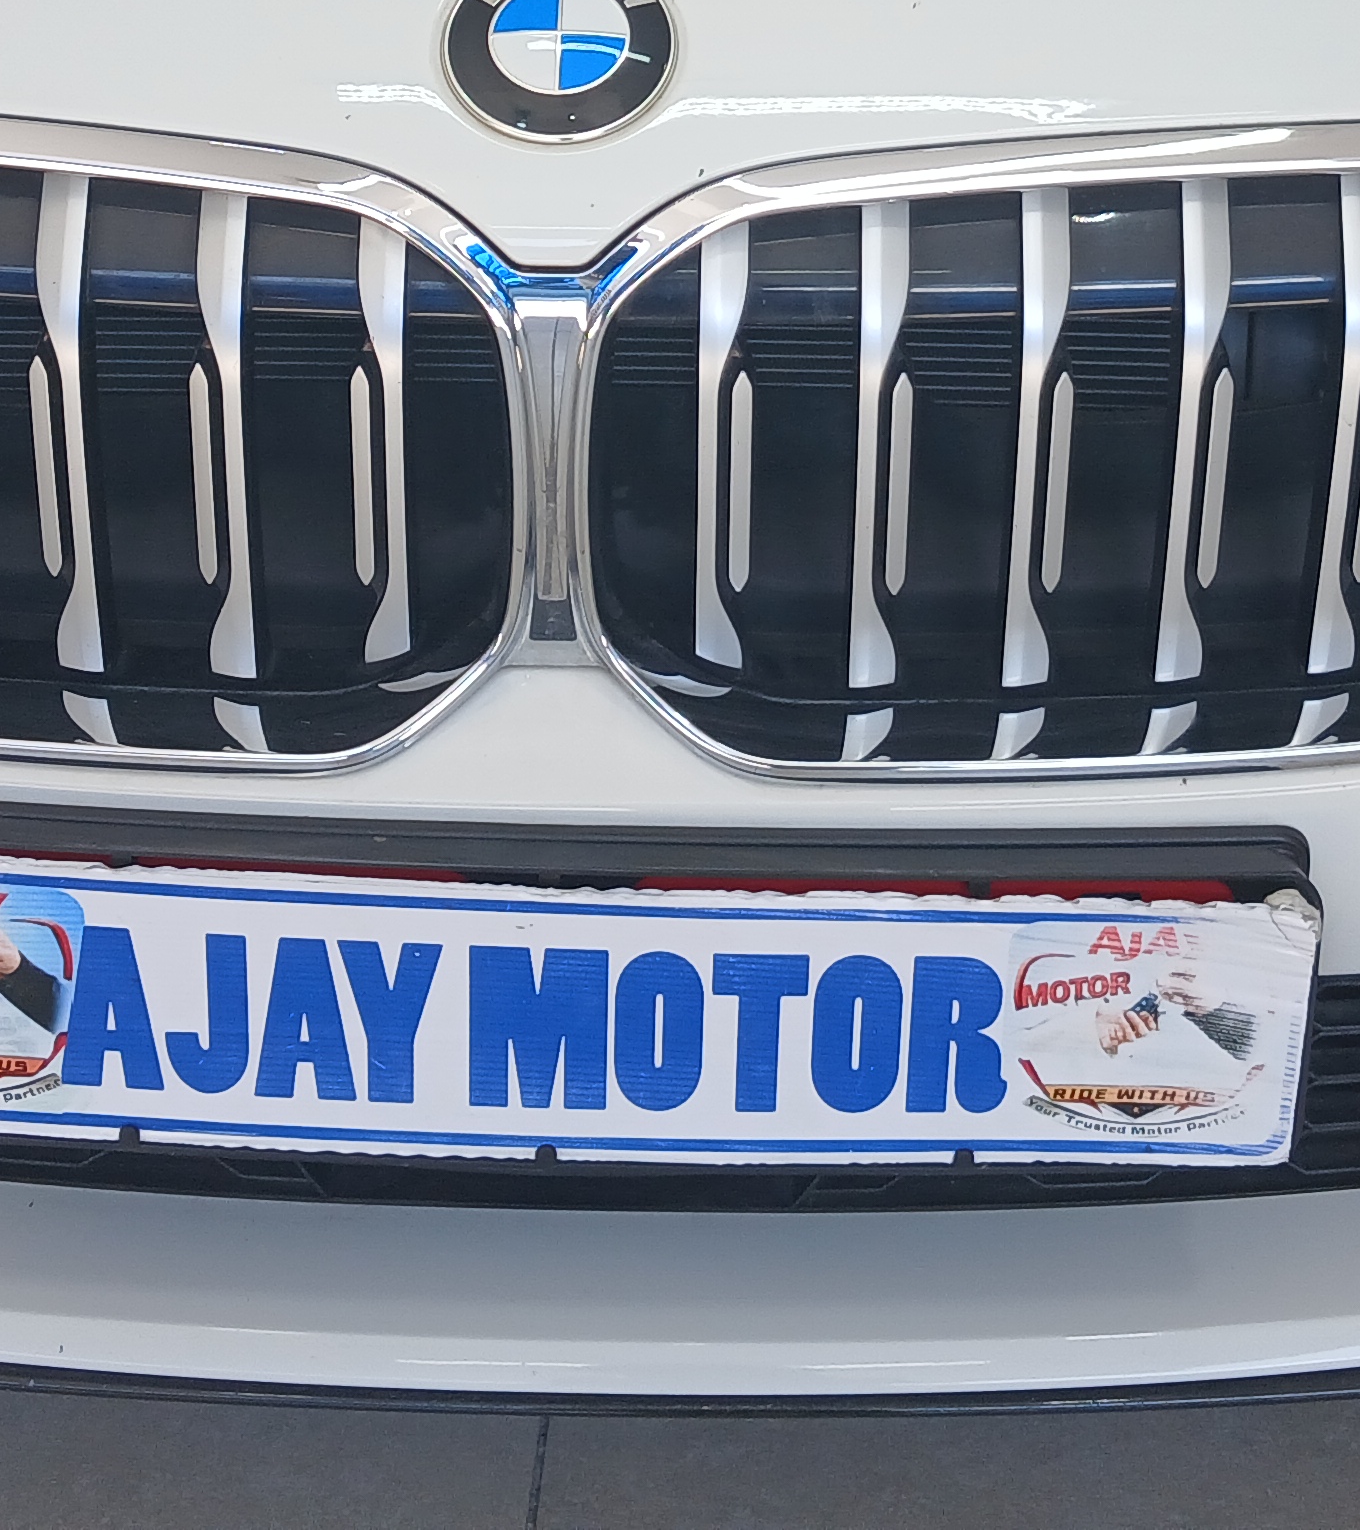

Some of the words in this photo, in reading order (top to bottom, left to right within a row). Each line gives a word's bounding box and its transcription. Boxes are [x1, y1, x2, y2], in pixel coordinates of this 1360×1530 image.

[1088, 925, 1200, 961] AJA
[1021, 971, 1131, 1008] MOTOR
[62, 925, 443, 1104] AJAY
[468, 944, 1008, 1113] MOTOR
[1052, 1087, 1108, 1102] RIDE
[1116, 1088, 1178, 1103] WITH
[1026, 1097, 1061, 1119] Your
[1065, 1113, 1127, 1136] Trusted
[1130, 1124, 1182, 1136] Motor
